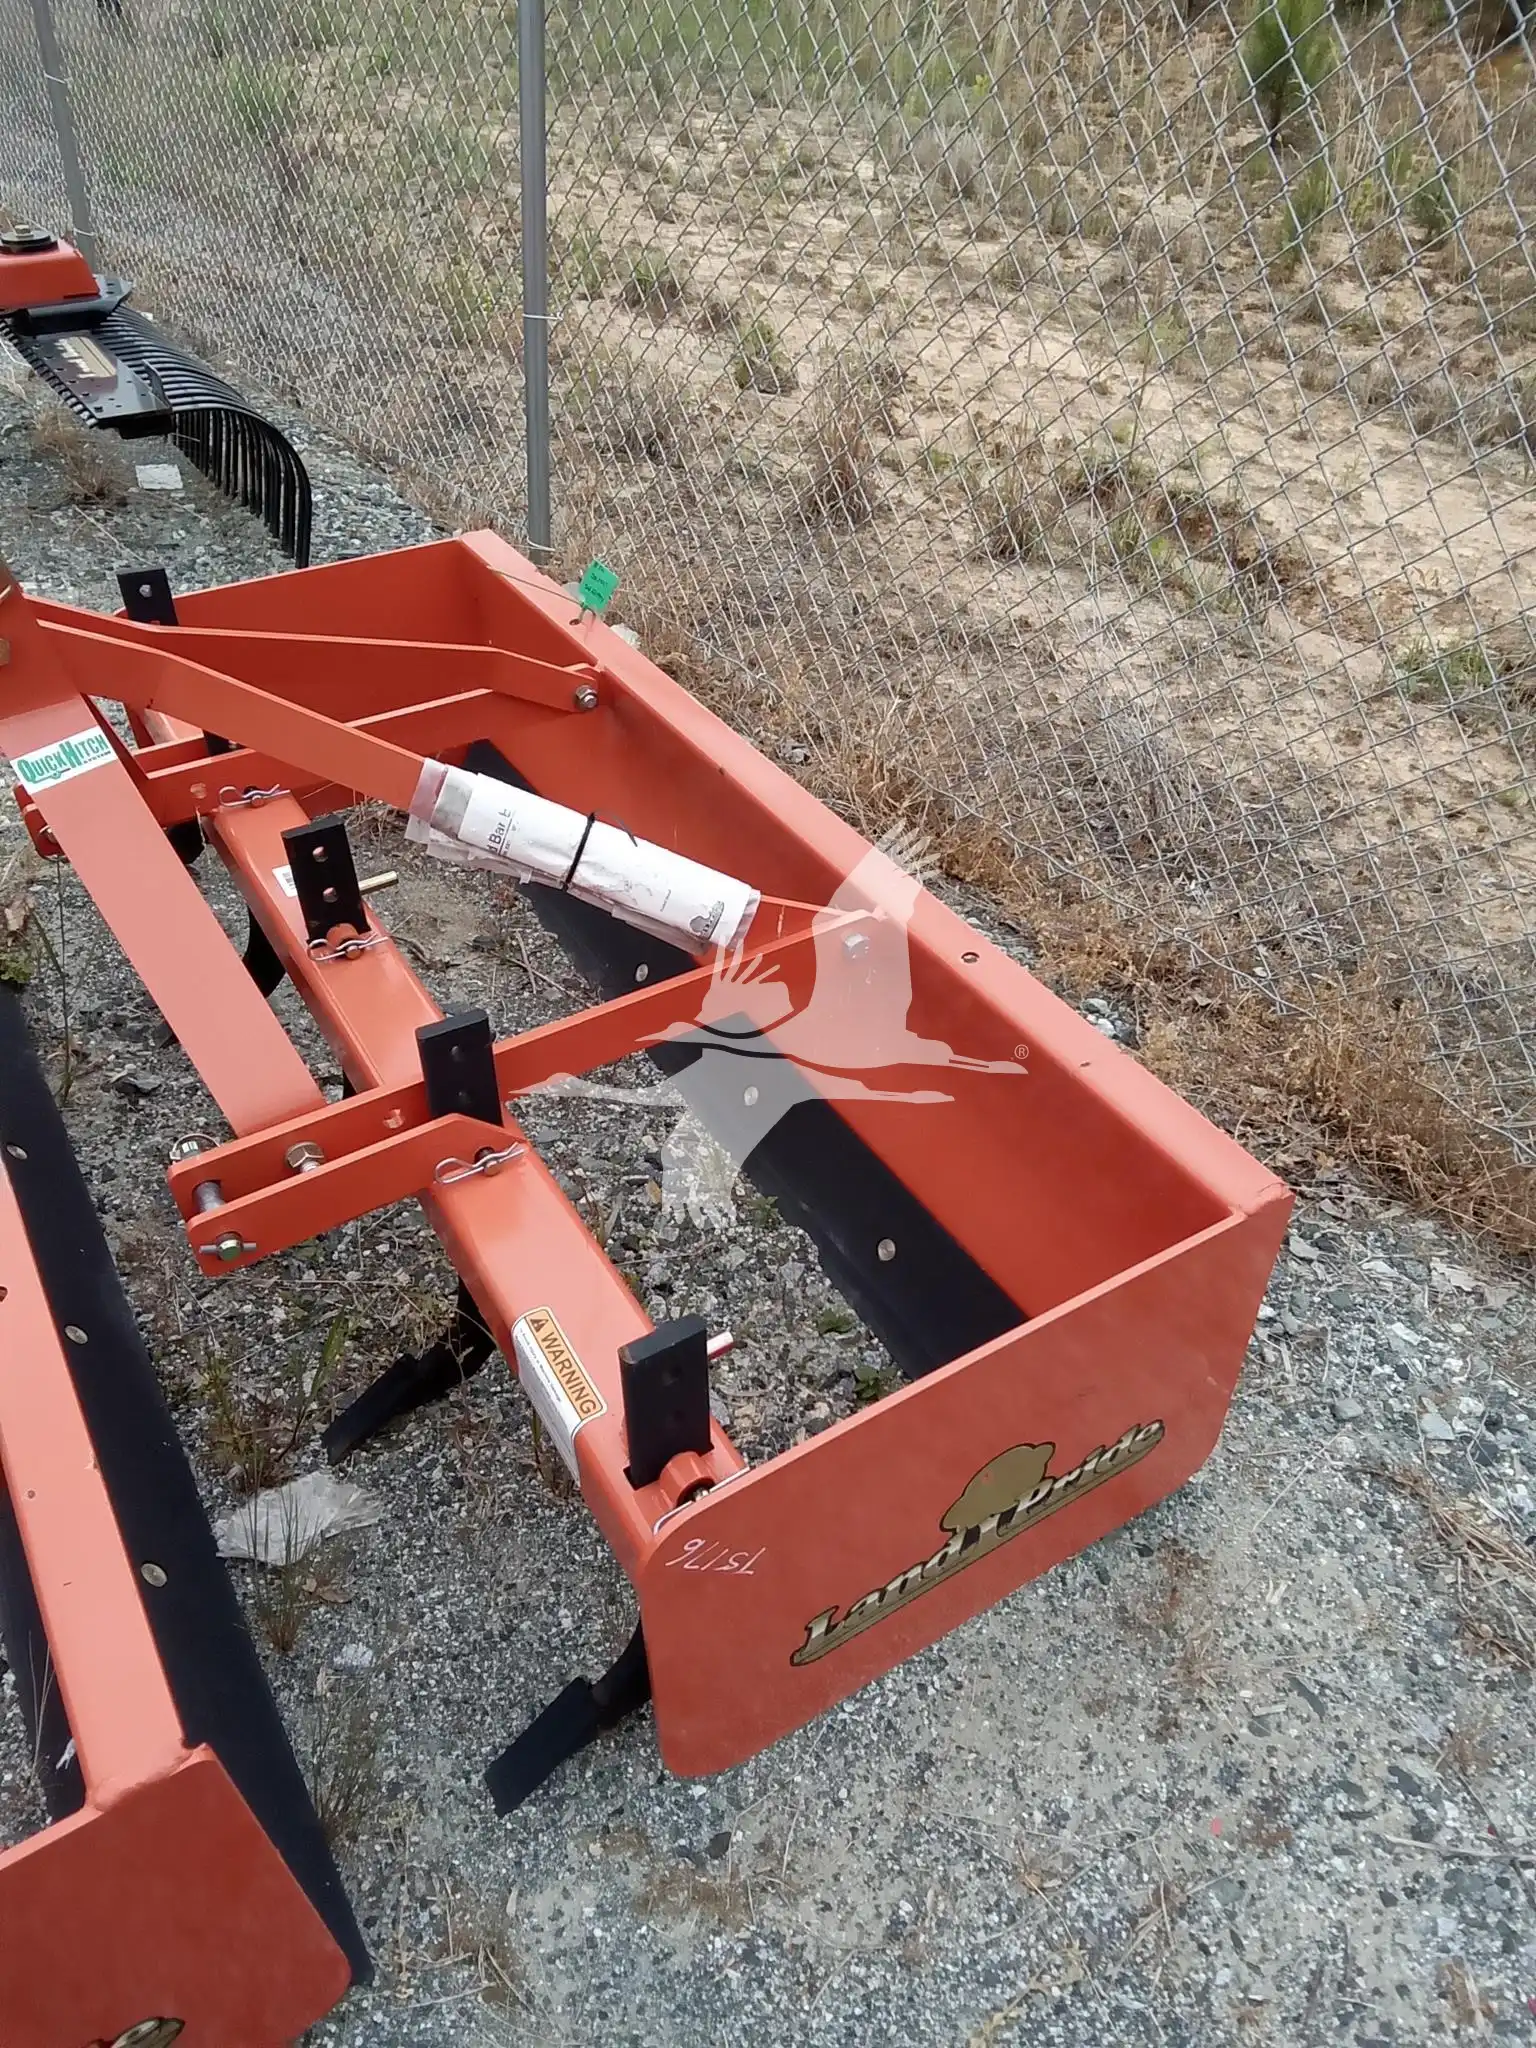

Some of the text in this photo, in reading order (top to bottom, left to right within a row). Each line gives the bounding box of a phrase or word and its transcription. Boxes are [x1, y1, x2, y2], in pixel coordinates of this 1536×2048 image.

[541, 1331, 597, 1415] WARNING
[789, 1419, 1165, 1666] Land Pride
